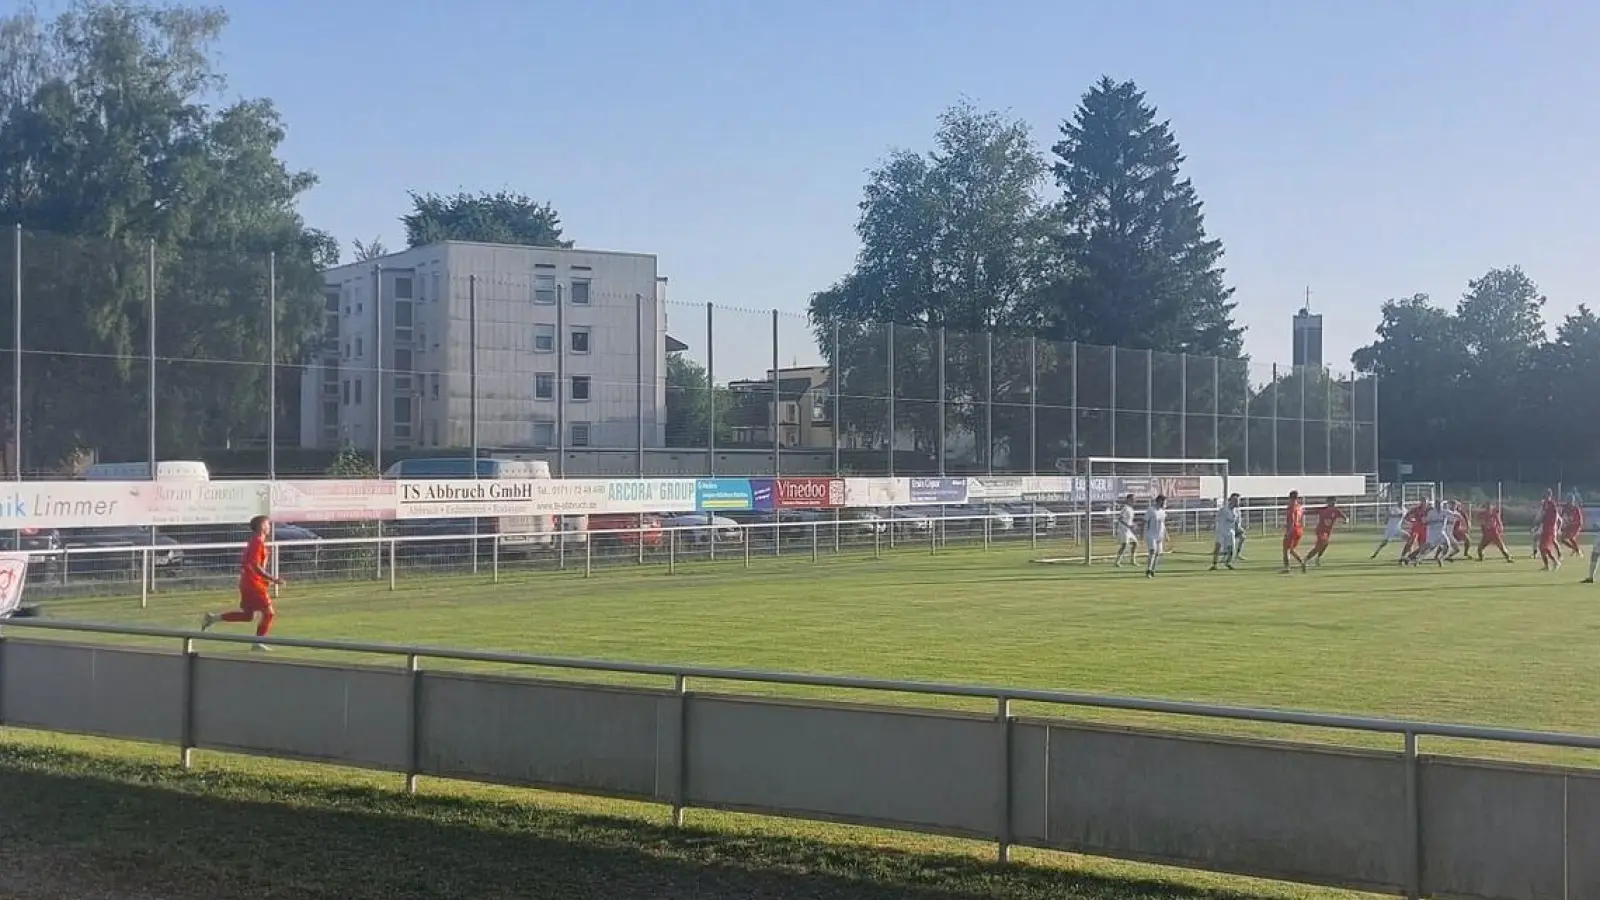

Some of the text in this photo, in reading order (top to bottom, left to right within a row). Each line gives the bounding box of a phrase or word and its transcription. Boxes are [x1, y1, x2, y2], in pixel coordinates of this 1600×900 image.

[401, 483, 420, 499] TS
[425, 483, 485, 499] Abbruch
[489, 482, 532, 498] GmbH
[608, 482, 653, 501] ARCORA
[659, 481, 694, 500] GROUP
[777, 480, 827, 498] Vinedoo
[34, 493, 118, 517] Limmer
